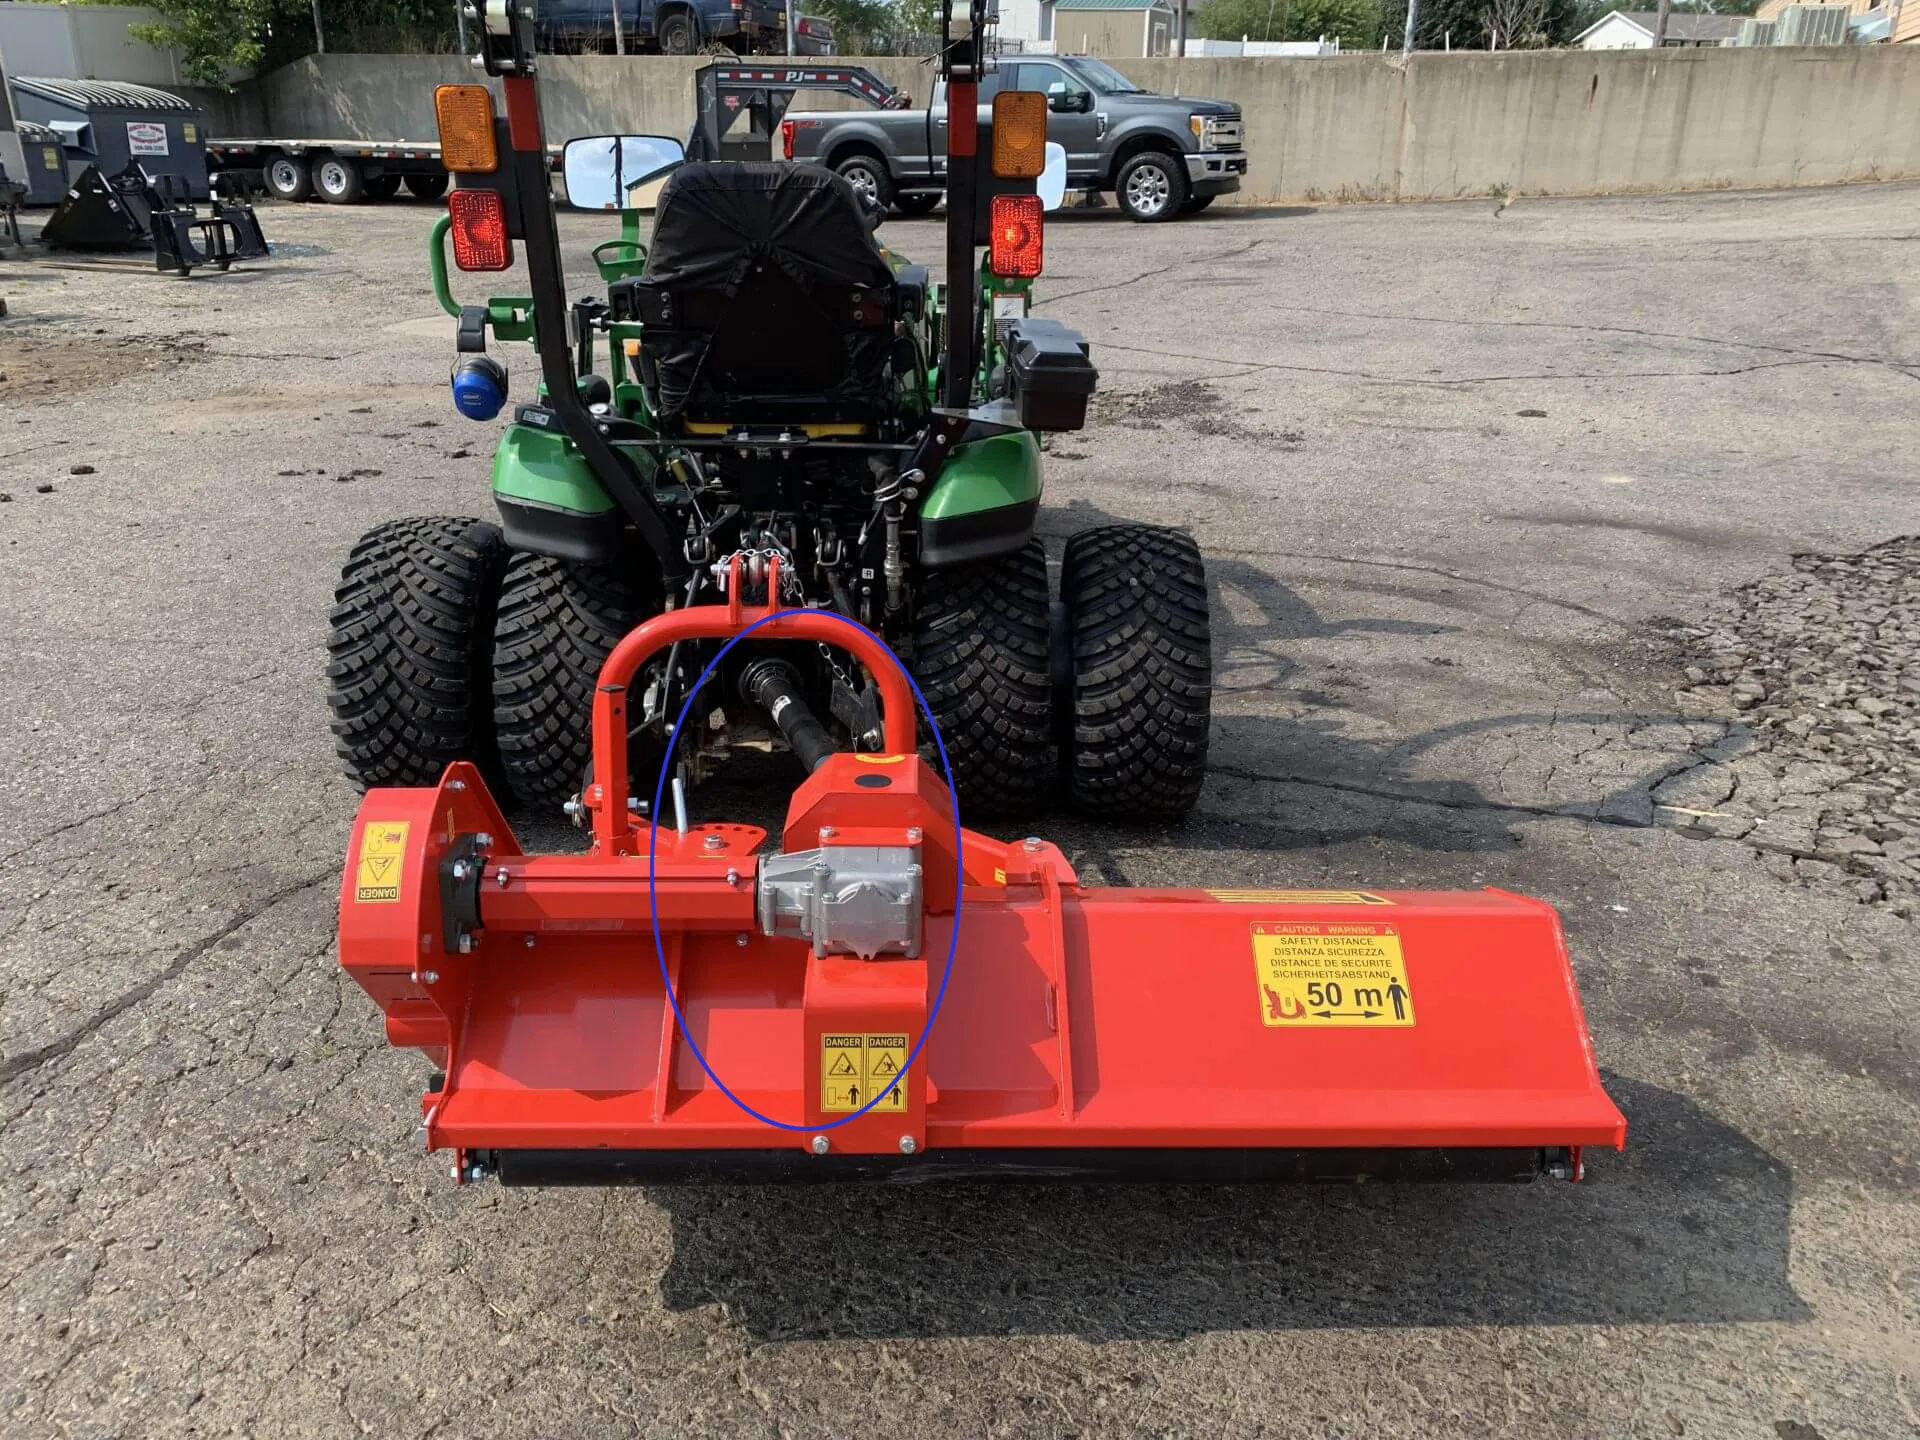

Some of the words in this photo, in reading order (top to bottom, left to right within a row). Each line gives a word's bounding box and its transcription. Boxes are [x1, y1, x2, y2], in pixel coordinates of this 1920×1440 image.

[785, 71, 804, 82] PJ
[360, 888, 396, 898] DANGER
[1274, 925, 1320, 934] CAUTION
[1327, 926, 1377, 935] WARNING
[1280, 937, 1320, 945] SAFETY
[1323, 937, 1374, 946] DISTANCE
[1274, 947, 1325, 956] DISTANZA
[1327, 948, 1385, 956] SICUREZZA
[1270, 959, 1321, 967] DISTANCE
[1324, 959, 1338, 967] DE
[1341, 959, 1393, 968] SECURITE
[1273, 970, 1390, 979] SICHERHEITSABSTAND
[1307, 982, 1343, 1007] 50
[1354, 988, 1383, 1007] m
[825, 1038, 861, 1047] DANGER
[869, 1038, 905, 1047] DANGER
